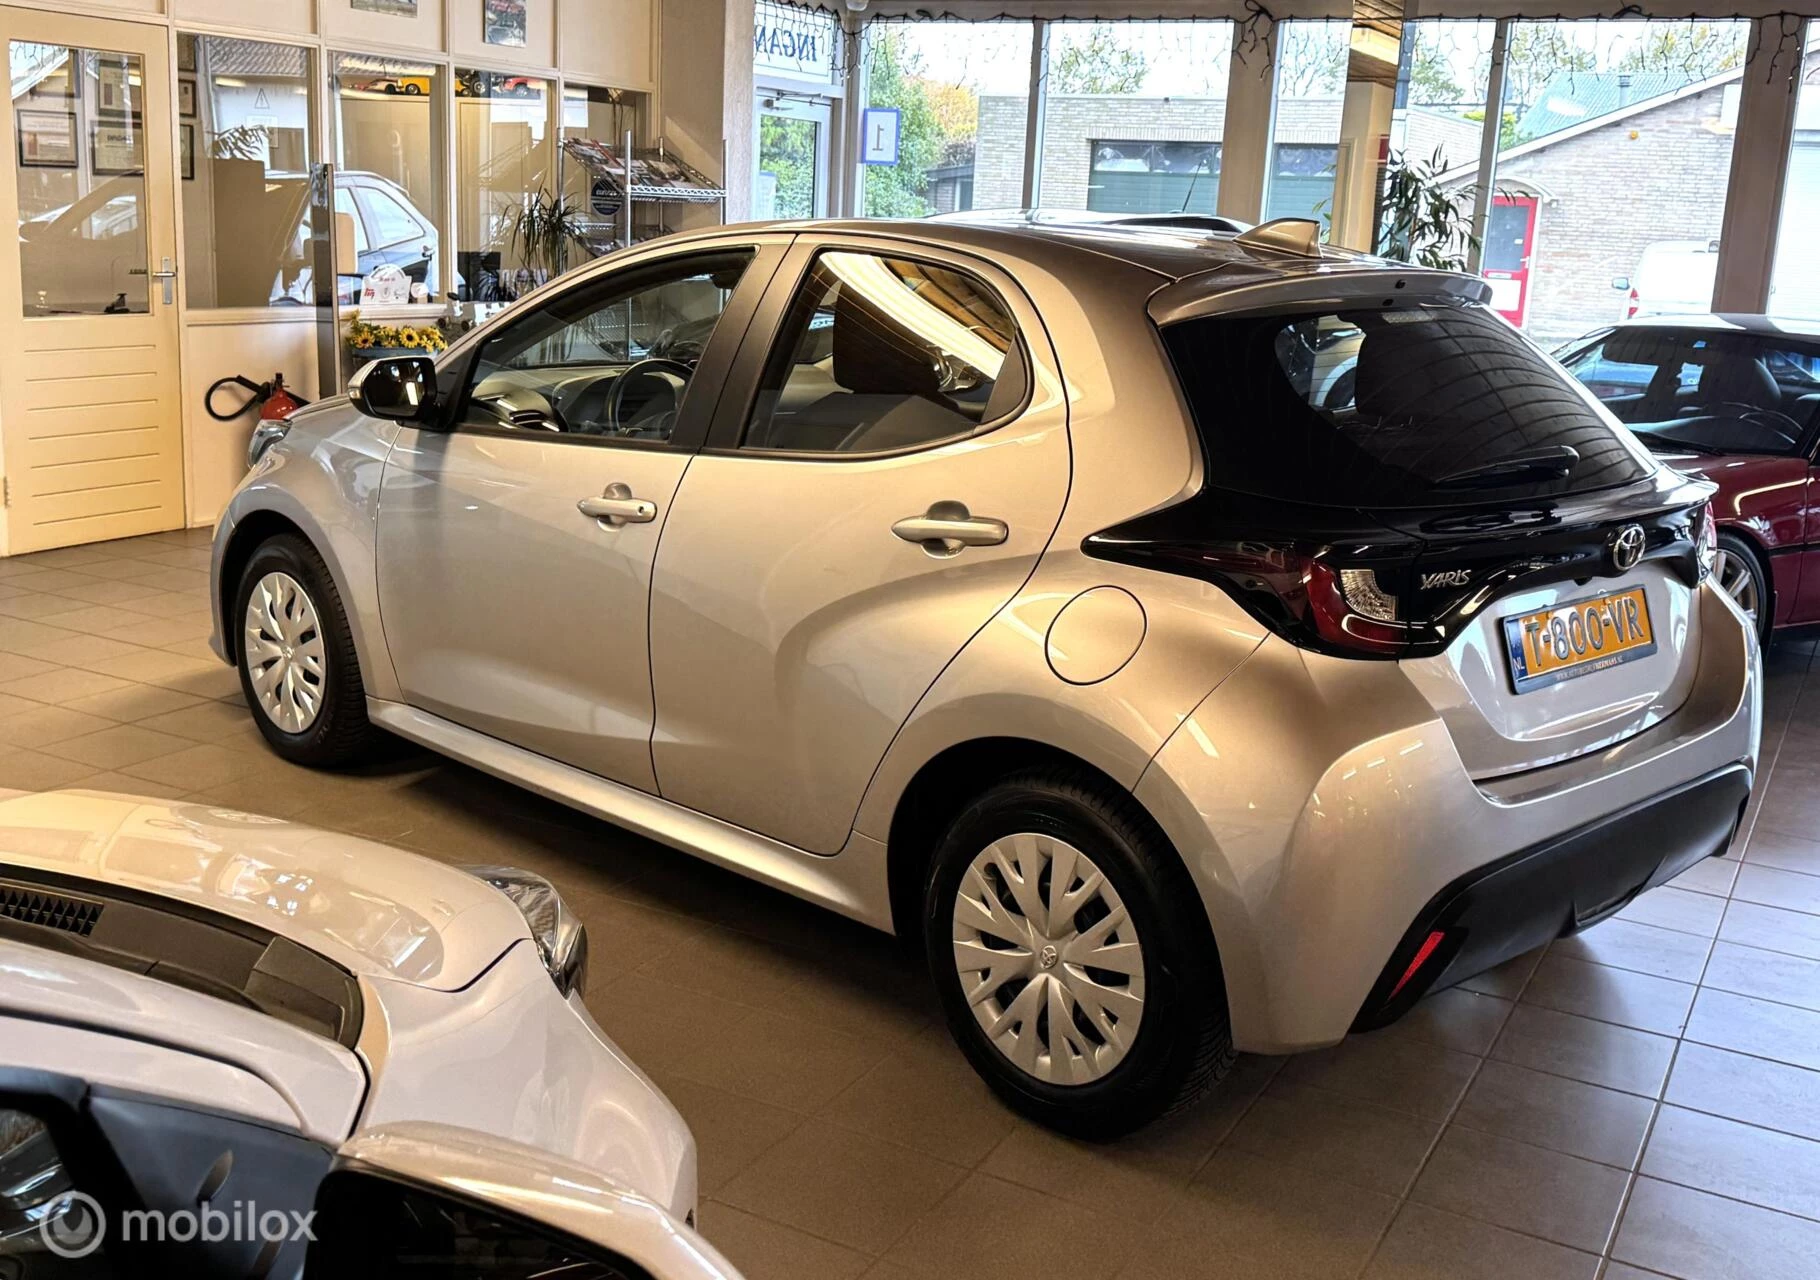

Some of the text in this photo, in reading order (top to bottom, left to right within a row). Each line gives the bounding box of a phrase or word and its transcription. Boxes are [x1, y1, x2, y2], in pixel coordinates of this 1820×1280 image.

[1421, 570, 1471, 589] YARIS
[1524, 597, 1644, 667] T-800-VR
[1512, 657, 1525, 672] NL
